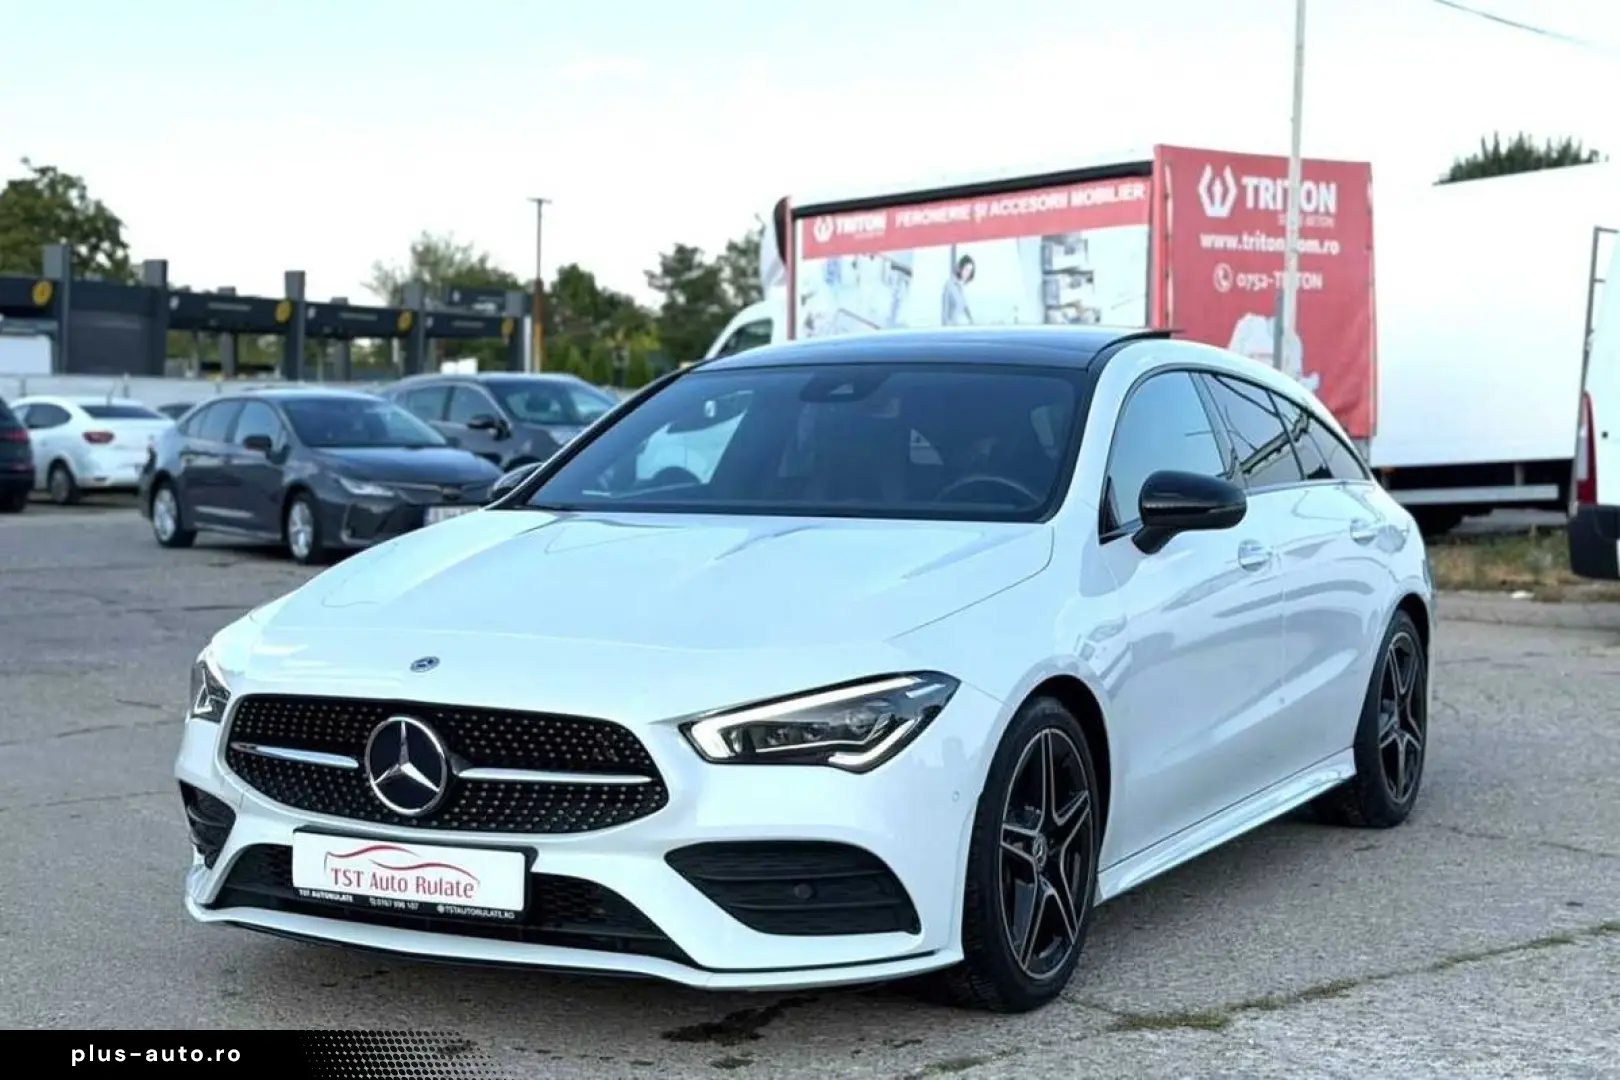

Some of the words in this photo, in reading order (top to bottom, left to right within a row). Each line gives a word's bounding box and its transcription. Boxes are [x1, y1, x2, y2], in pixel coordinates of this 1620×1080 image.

[989, 192, 1069, 217] ACCESORII
[1070, 183, 1145, 208] MOBILIER
[331, 868, 364, 888] TST
[369, 871, 409, 893] Auto
[415, 875, 475, 899] Rulate
